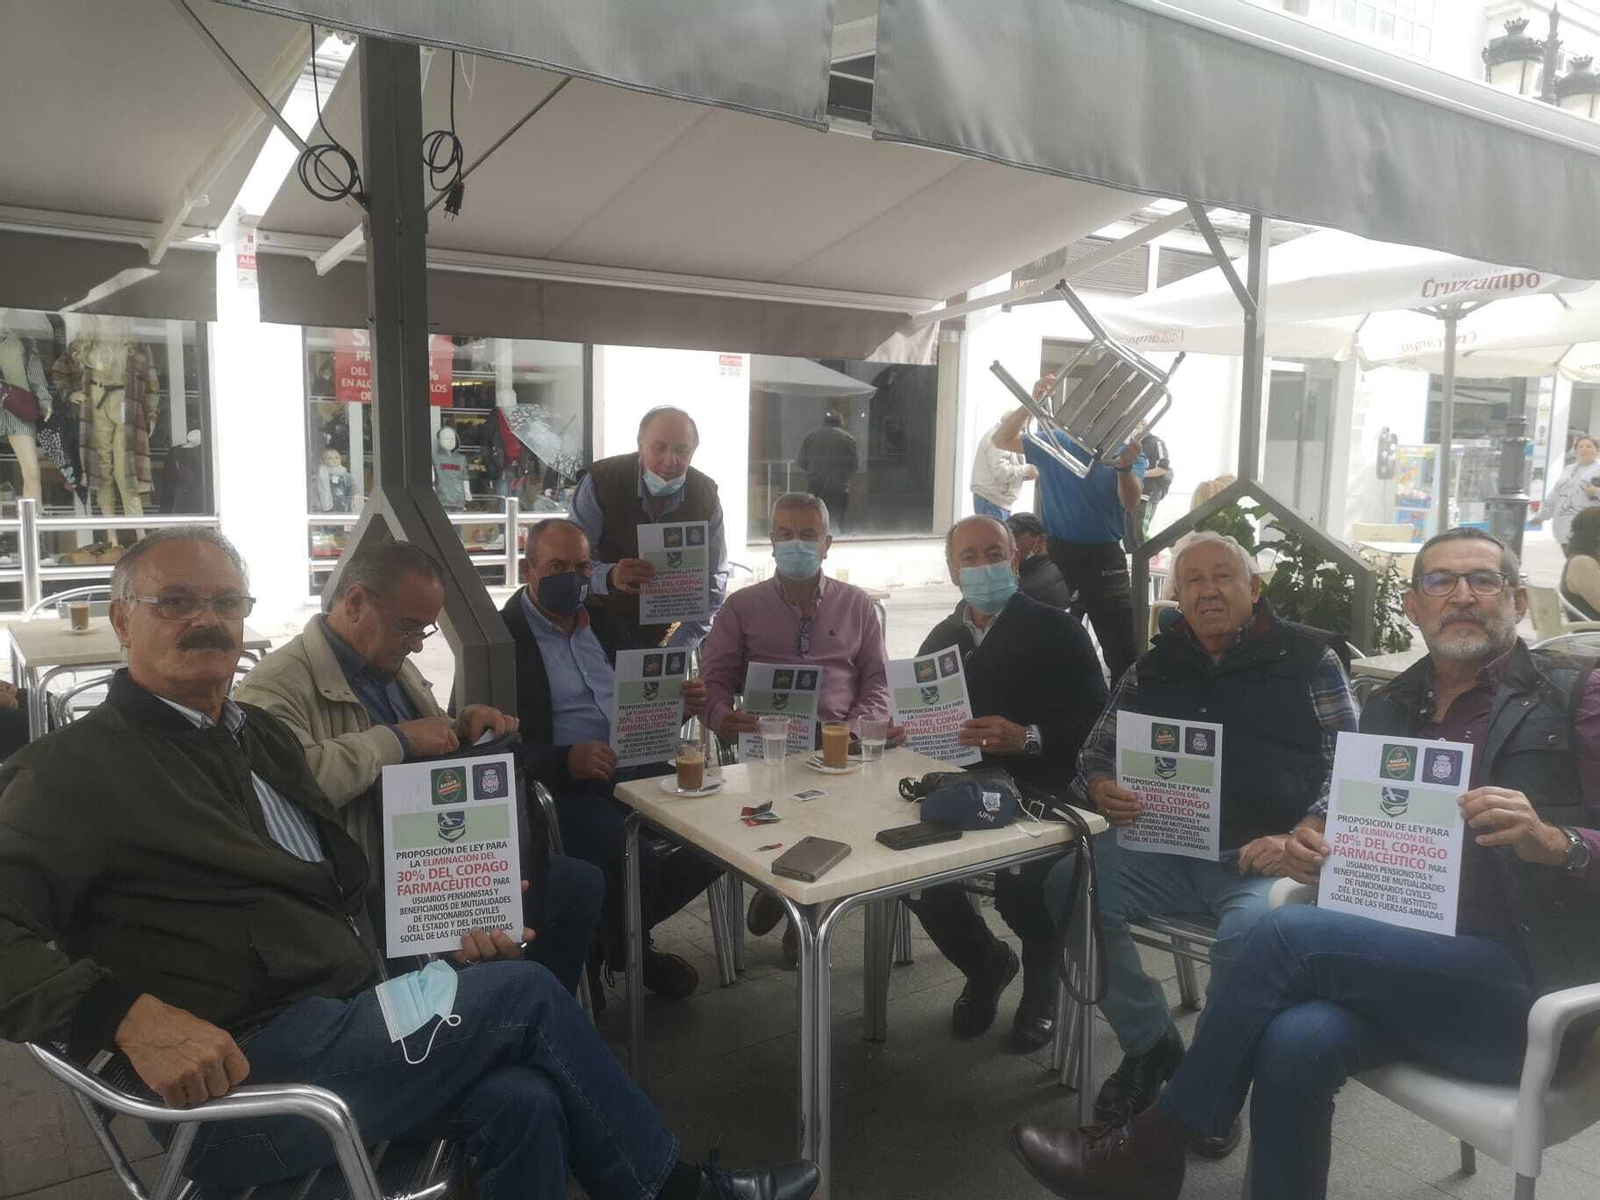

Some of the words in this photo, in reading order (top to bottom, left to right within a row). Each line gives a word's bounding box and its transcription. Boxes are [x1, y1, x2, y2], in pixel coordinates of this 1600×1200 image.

[1421, 273, 1540, 298] Cruzcampo
[350, 366, 368, 376] DEL
[342, 378, 354, 387] EN
[920, 717, 935, 727] DEL
[936, 712, 968, 724] COPAGO
[1145, 792, 1164, 803] DEL
[1167, 795, 1209, 810] COPAGO
[1348, 825, 1358, 833] LA
[1418, 834, 1435, 844] DEL
[1394, 822, 1406, 830] DE
[1408, 824, 1423, 833] LEY
[1425, 826, 1449, 837] PARA
[456, 845, 468, 853] DE
[469, 843, 483, 852] LEY
[486, 841, 507, 850] PARA
[1334, 832, 1361, 846] 30%
[1364, 837, 1388, 850] DEL
[1391, 840, 1447, 860] COPAGO
[409, 859, 420, 868] LA
[480, 851, 495, 860] DEL
[1428, 863, 1446, 873] PARA
[396, 869, 424, 883] 30%
[428, 866, 452, 879] DEL
[455, 860, 508, 876] COPAGO
[1345, 859, 1378, 872] USUARIOS
[1379, 865, 1426, 880] PENSIONISTAS
[397, 875, 490, 895] FARMACÉUTICO
[493, 876, 509, 885] PARA
[1333, 866, 1380, 882] BENEFICIARIOS
[1381, 875, 1391, 883] DE
[1392, 876, 1445, 893] MUTUALIDADES
[1344, 877, 1353, 885] DE
[1354, 878, 1404, 895] FUNCIONARIOS
[1404, 888, 1431, 900] CIVILES
[399, 902, 447, 915] BENEFICIARIOS
[460, 895, 511, 908] MUTUALIDADES
[412, 894, 445, 904] USUARIOS
[447, 888, 492, 900] PENSIONISTAS
[1337, 884, 1350, 894] DEL
[1352, 887, 1378, 899] ESTADO
[1386, 893, 1399, 903] DEL
[1400, 896, 1437, 910] INSTITUTO
[413, 914, 422, 922] DE
[423, 909, 473, 921] FUNCIONARIOS
[474, 906, 499, 915] CIVILES
[1330, 892, 1352, 903] SOCIAL
[1354, 896, 1363, 905] DE
[1364, 898, 1377, 907] LAS
[1378, 901, 1407, 914] FUERZAS
[1408, 906, 1444, 921] ARMADAS
[407, 924, 419, 932] DEL
[422, 920, 448, 931] ESTADO
[456, 918, 469, 926] DEL
[471, 914, 505, 925] INSTITUTO
[400, 932, 423, 943] SOCIAL
[425, 931, 435, 940] DE
[436, 930, 448, 938] LAS
